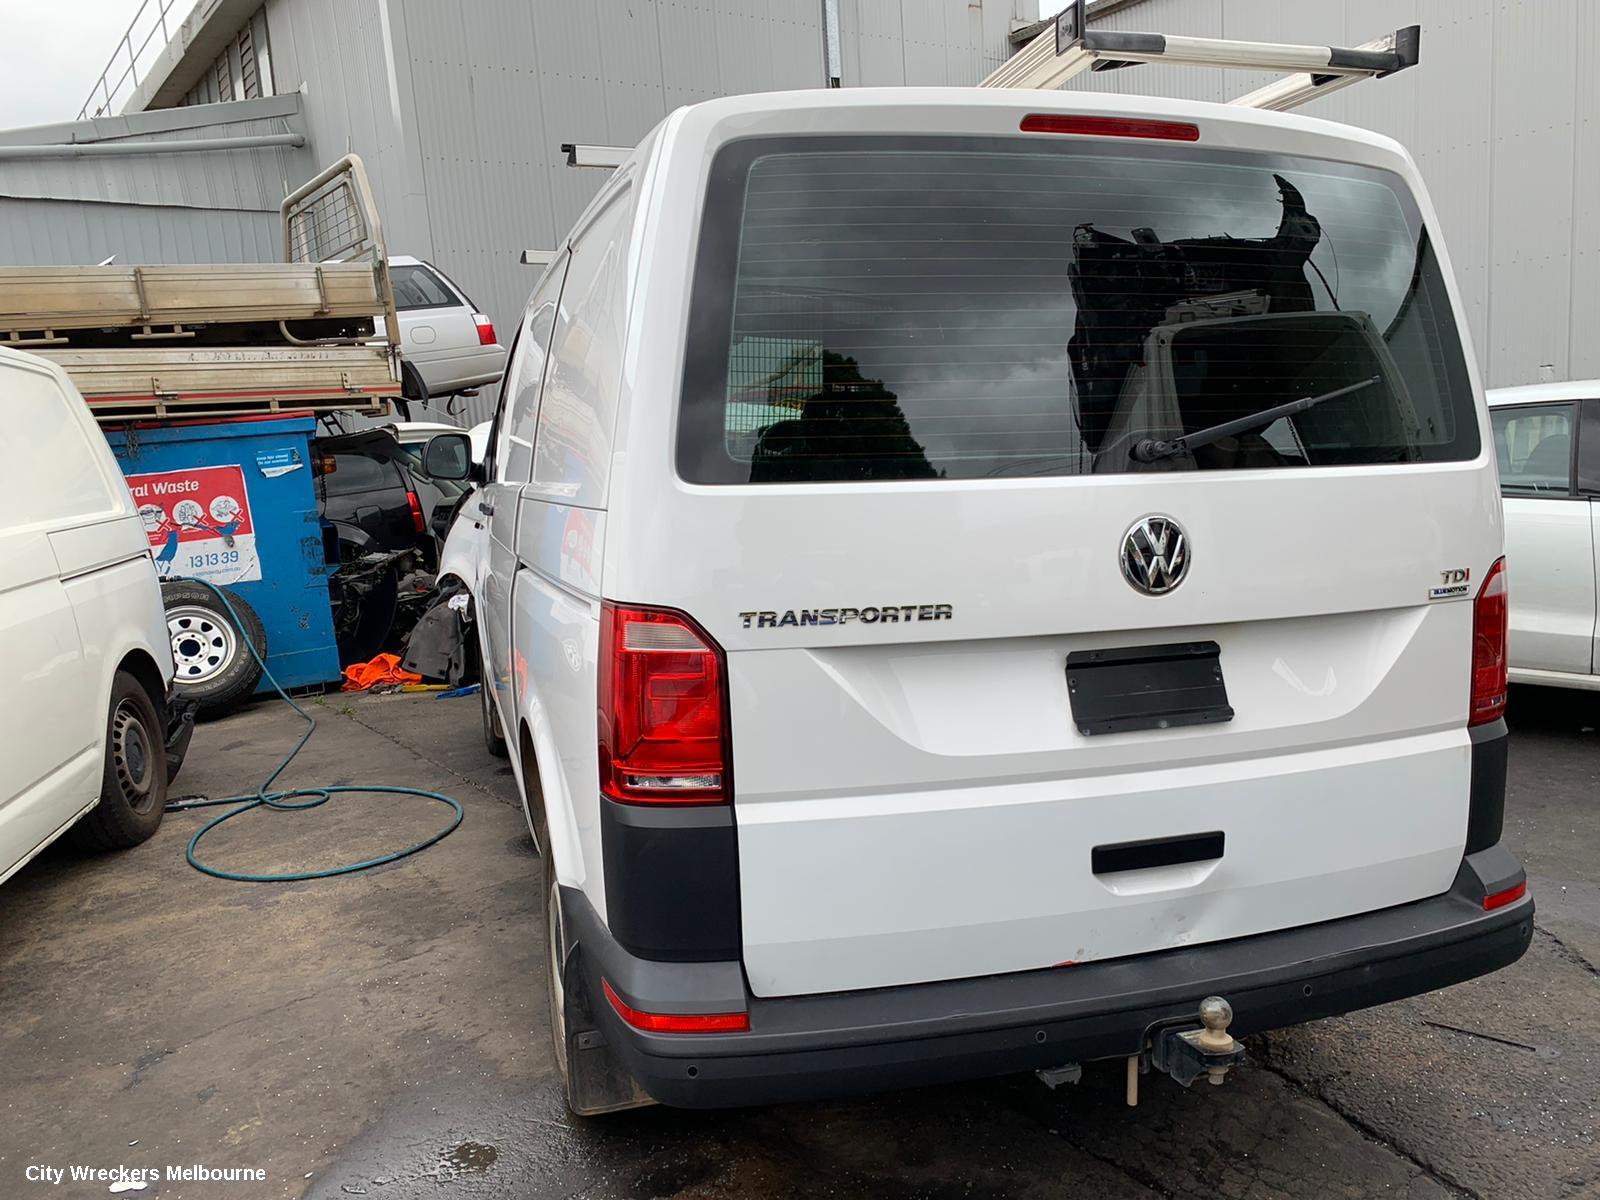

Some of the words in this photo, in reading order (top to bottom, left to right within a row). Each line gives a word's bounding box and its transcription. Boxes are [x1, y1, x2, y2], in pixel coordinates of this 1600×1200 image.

[152, 480, 199, 495] Waste
[1440, 567, 1470, 585] TDI
[738, 603, 953, 629] TRANSPORTER
